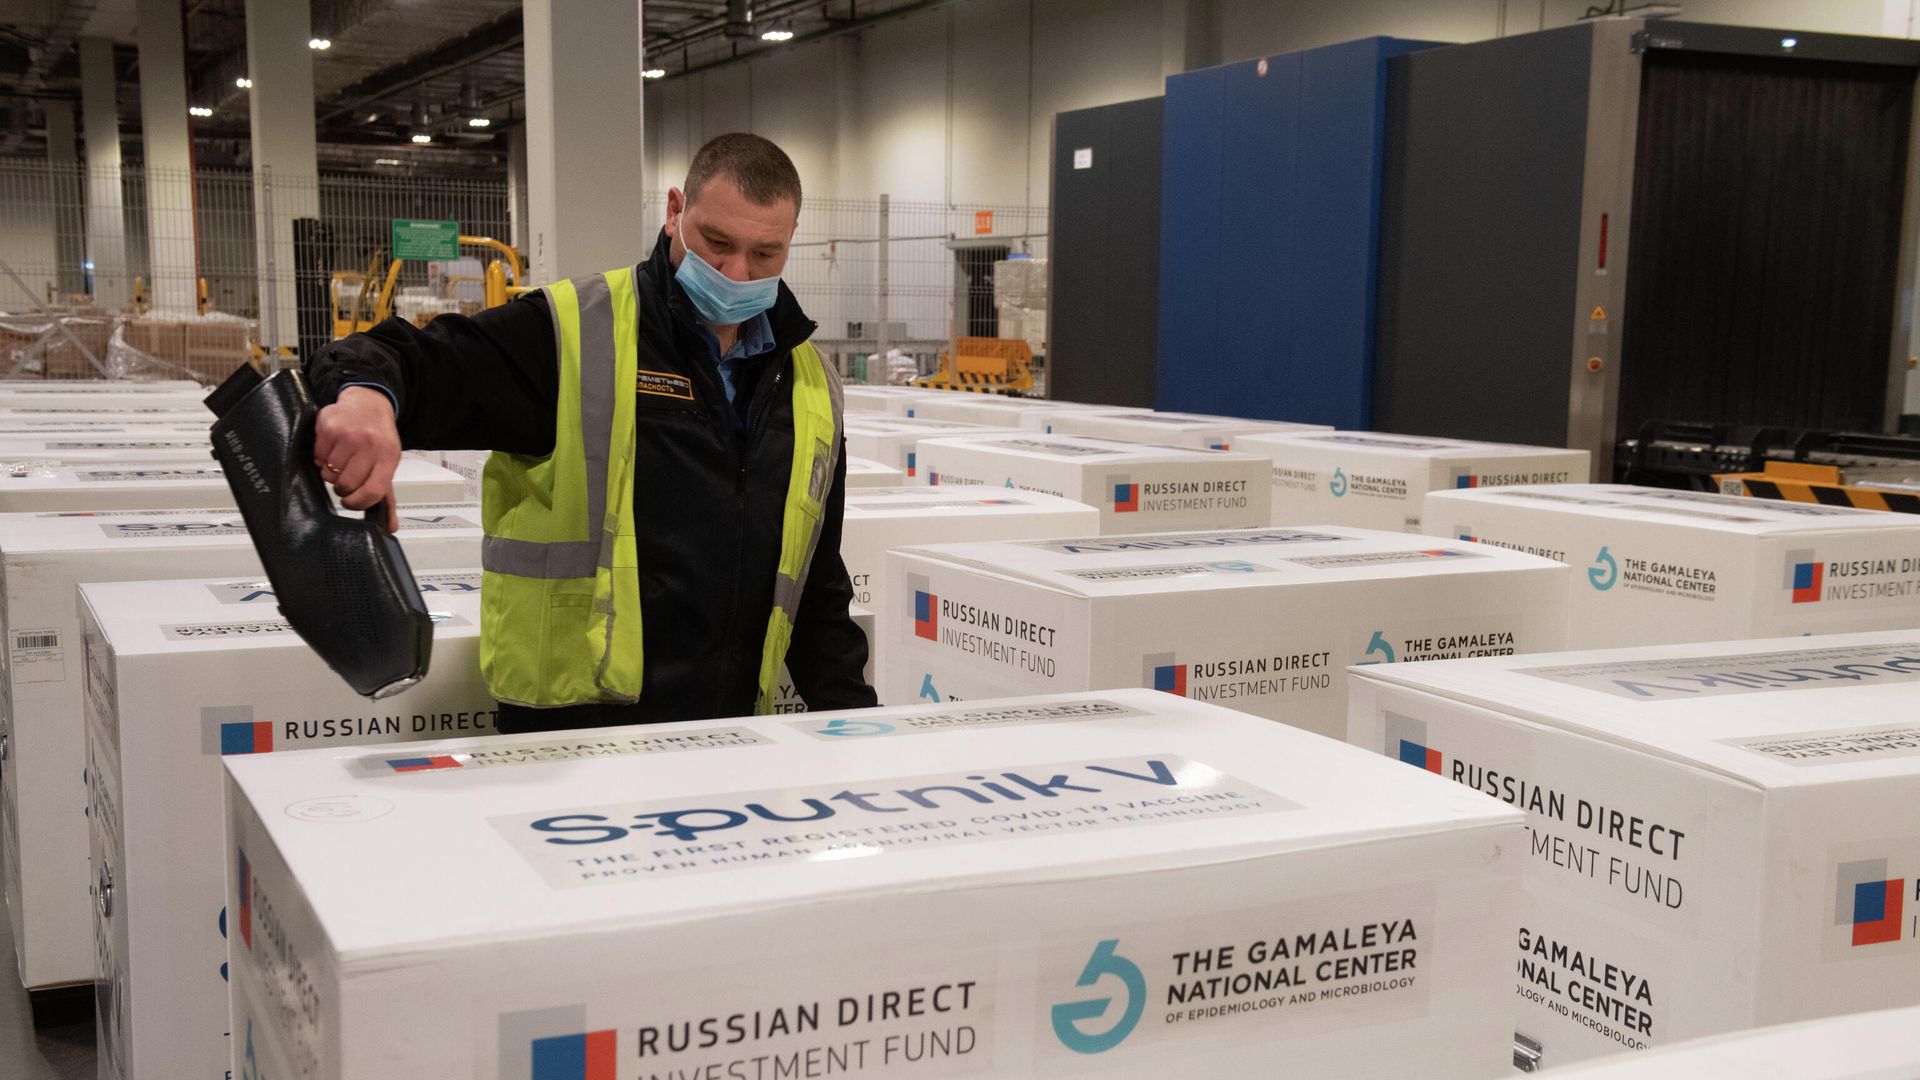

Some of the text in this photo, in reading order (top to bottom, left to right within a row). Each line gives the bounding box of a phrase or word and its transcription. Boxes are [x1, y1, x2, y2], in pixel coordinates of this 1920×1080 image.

[636, 382, 674, 392] ПАСНОСТЬ
[1144, 480, 1247, 494] RUSSIAN DIRECT
[1351, 474, 1406, 487] THE GAMALEYA
[1351, 483, 1406, 495] NATIONAL CENTER
[1482, 472, 1569, 485] RUSSIAN DIRECT
[1143, 496, 1247, 512] INVESTMENT FUND
[1624, 571, 1716, 594] NATIONAL CENTER
[1625, 558, 1716, 582] THE GAMALEYA
[1829, 559, 1896, 578] RUSSIAN
[1827, 580, 1913, 600] INVESTMENT
[943, 599, 1056, 648] RUSSIAN DIRECT
[942, 627, 1056, 678] INVESTMENT FUND
[1405, 632, 1514, 652] THE GAMALEYA
[1194, 652, 1330, 679] RUSSIAN DIRECT
[1193, 674, 1330, 701] INVESTMENT FUND
[285, 711, 500, 740] RUSSIAN DIRECT
[899, 714, 955, 722] THE
[963, 703, 1110, 717] GAMALEYA
[909, 714, 1027, 727] NATIONAL
[1034, 706, 1121, 717] CENTER
[469, 731, 742, 759] RUSSIAN DIRECT
[477, 736, 758, 767] INVESTMENT FUND
[530, 760, 1178, 846] Sputnik V
[1451, 757, 1565, 822] RUSSIAN
[1577, 799, 1686, 862] DIRECT
[567, 790, 1246, 868] THE FIRST REGISTERED COVID-19 VACCINE
[580, 861, 697, 880] PROVEN
[711, 848, 813, 866] HUMAN
[1000, 818, 1101, 834] VECTOR
[1109, 800, 1263, 823] TECHNOLOGY
[1609, 856, 1684, 910] FUND
[1172, 919, 1418, 976] THE GAMALEYA
[1166, 948, 1417, 1006] NATIONAL CENTER
[1518, 927, 1653, 1007] GAMALEYA
[1165, 976, 1417, 1024] OF EPIDEMIOLOGY AND MICROBIOLOGY
[1568, 980, 1653, 1038] CENTER
[637, 981, 977, 1057] RUSSIAN DIRECT
[1548, 999, 1650, 1051] AND MICROBIOLOG
[885, 1025, 977, 1066] FUND
